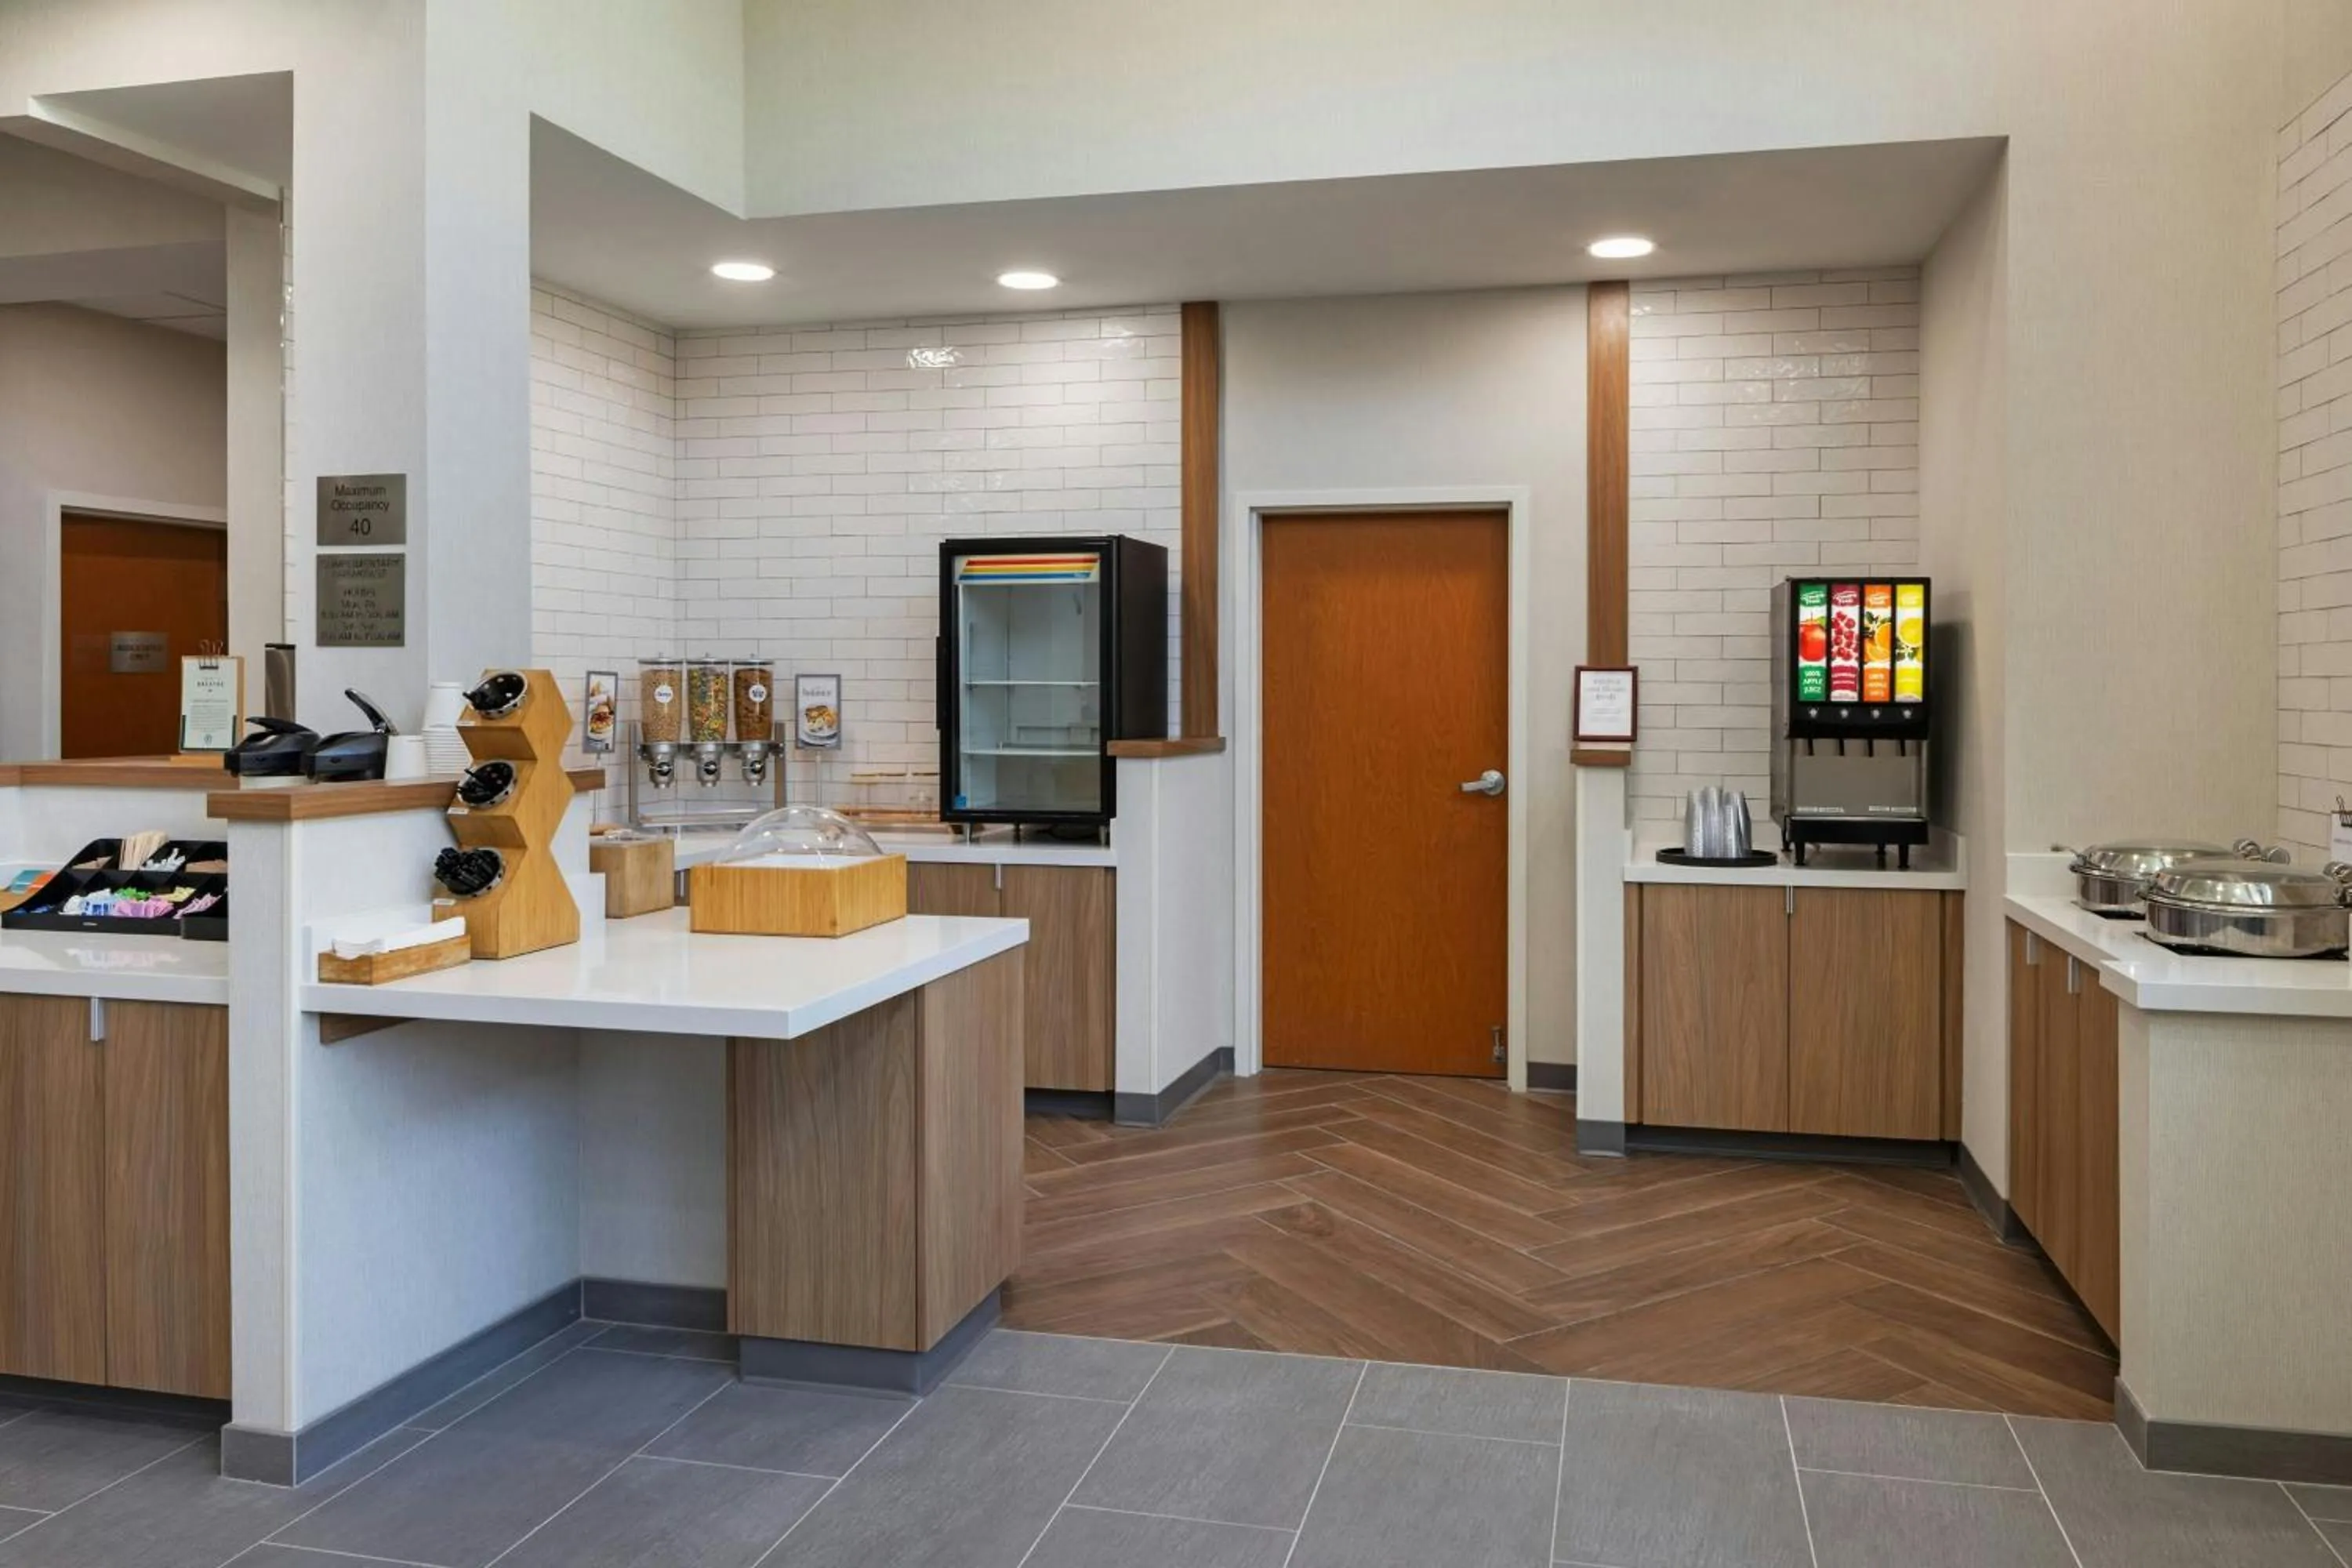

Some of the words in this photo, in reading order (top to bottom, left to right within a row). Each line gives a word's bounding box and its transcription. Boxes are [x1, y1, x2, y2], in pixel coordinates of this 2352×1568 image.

[335, 485, 387, 496] Maximum
[331, 499, 390, 512] Occupancy
[350, 518, 371, 535] 40
